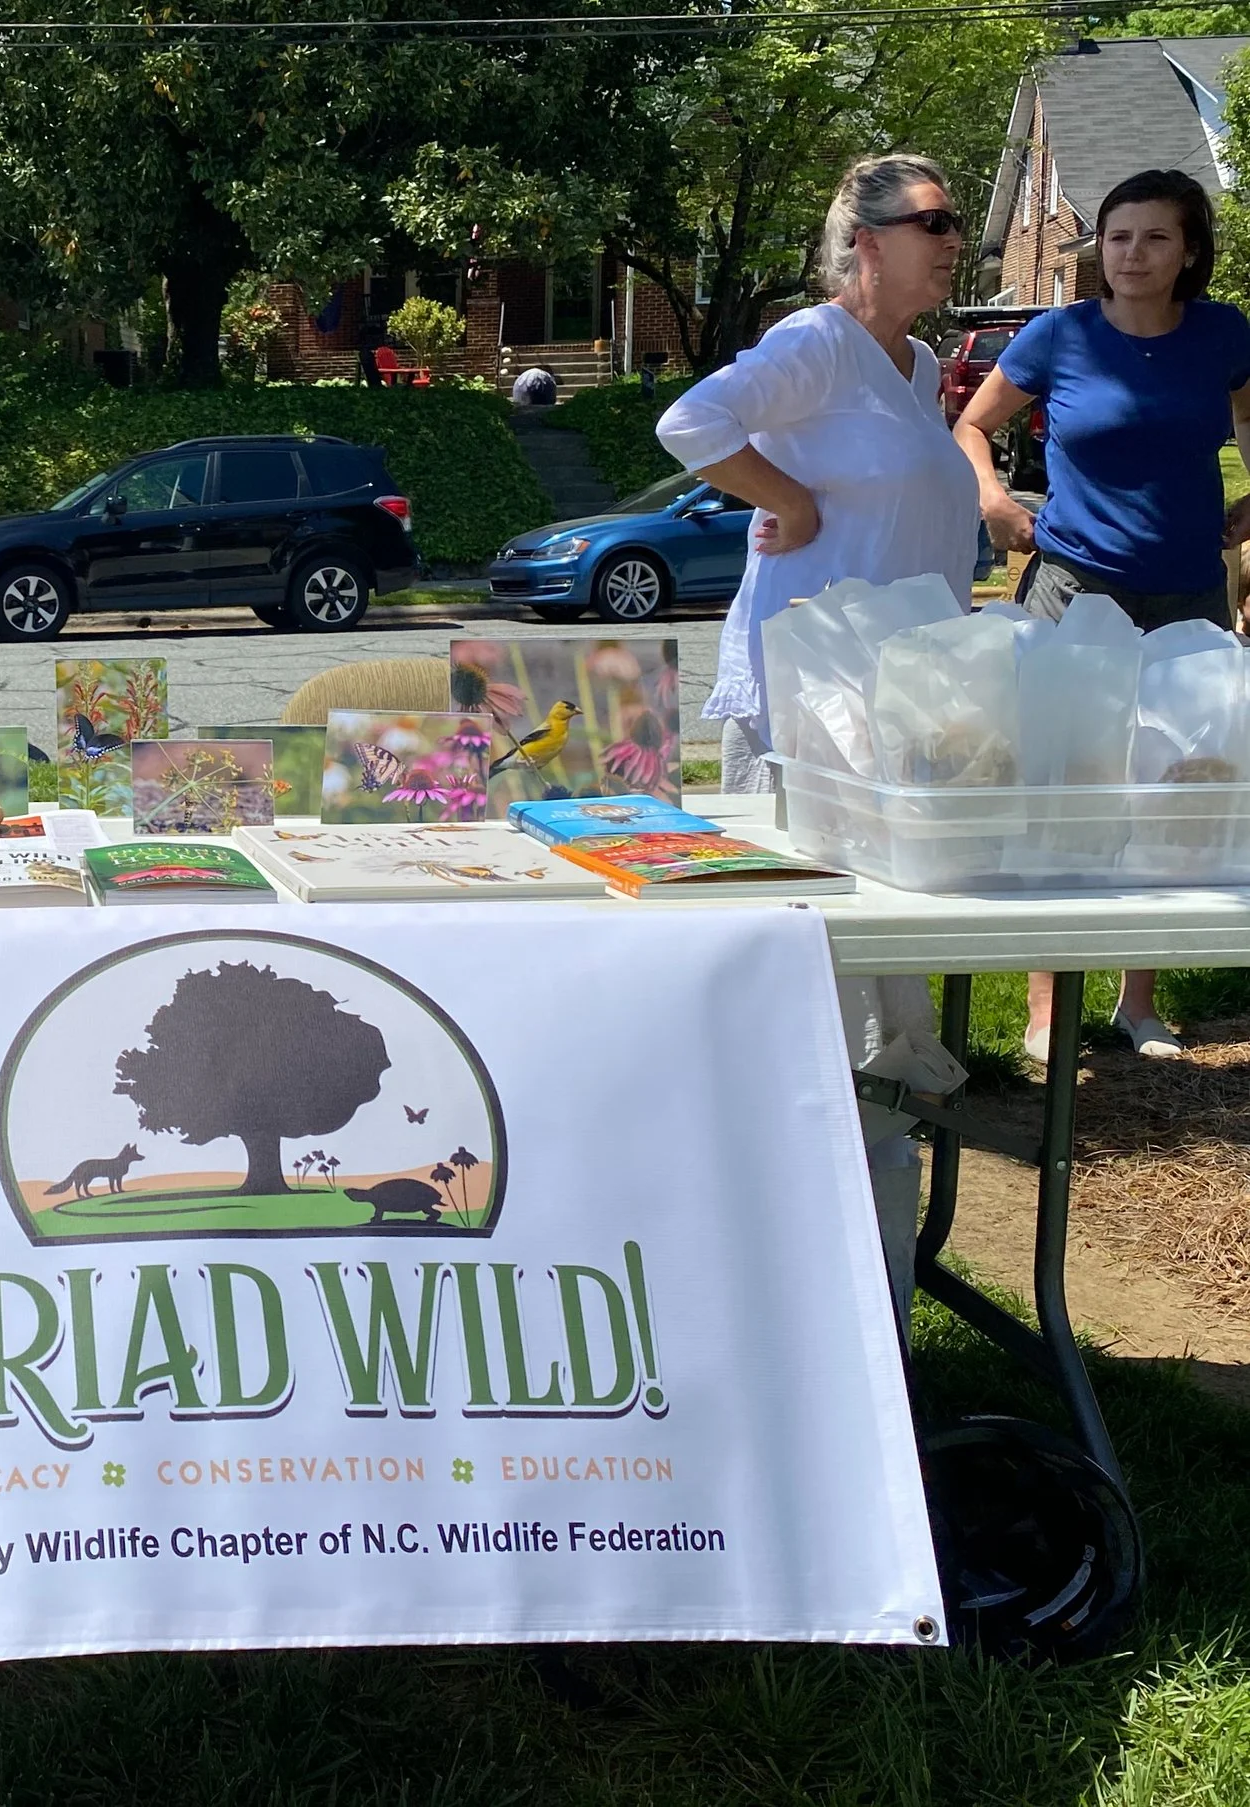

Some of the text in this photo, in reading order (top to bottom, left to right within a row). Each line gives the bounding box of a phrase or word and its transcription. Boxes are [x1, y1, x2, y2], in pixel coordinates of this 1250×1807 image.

[8, 852, 72, 862] WILD
[304, 1240, 670, 1421] WILD!
[157, 1456, 426, 1485] CONSERVATION
[501, 1455, 675, 1482] EDUCATION
[25, 1527, 160, 1564] Wildlife
[170, 1526, 308, 1567] Chapter
[319, 1523, 352, 1556] of
[363, 1523, 429, 1555] N.C.
[437, 1521, 559, 1553] Wildlife
[569, 1520, 726, 1552] Federation
